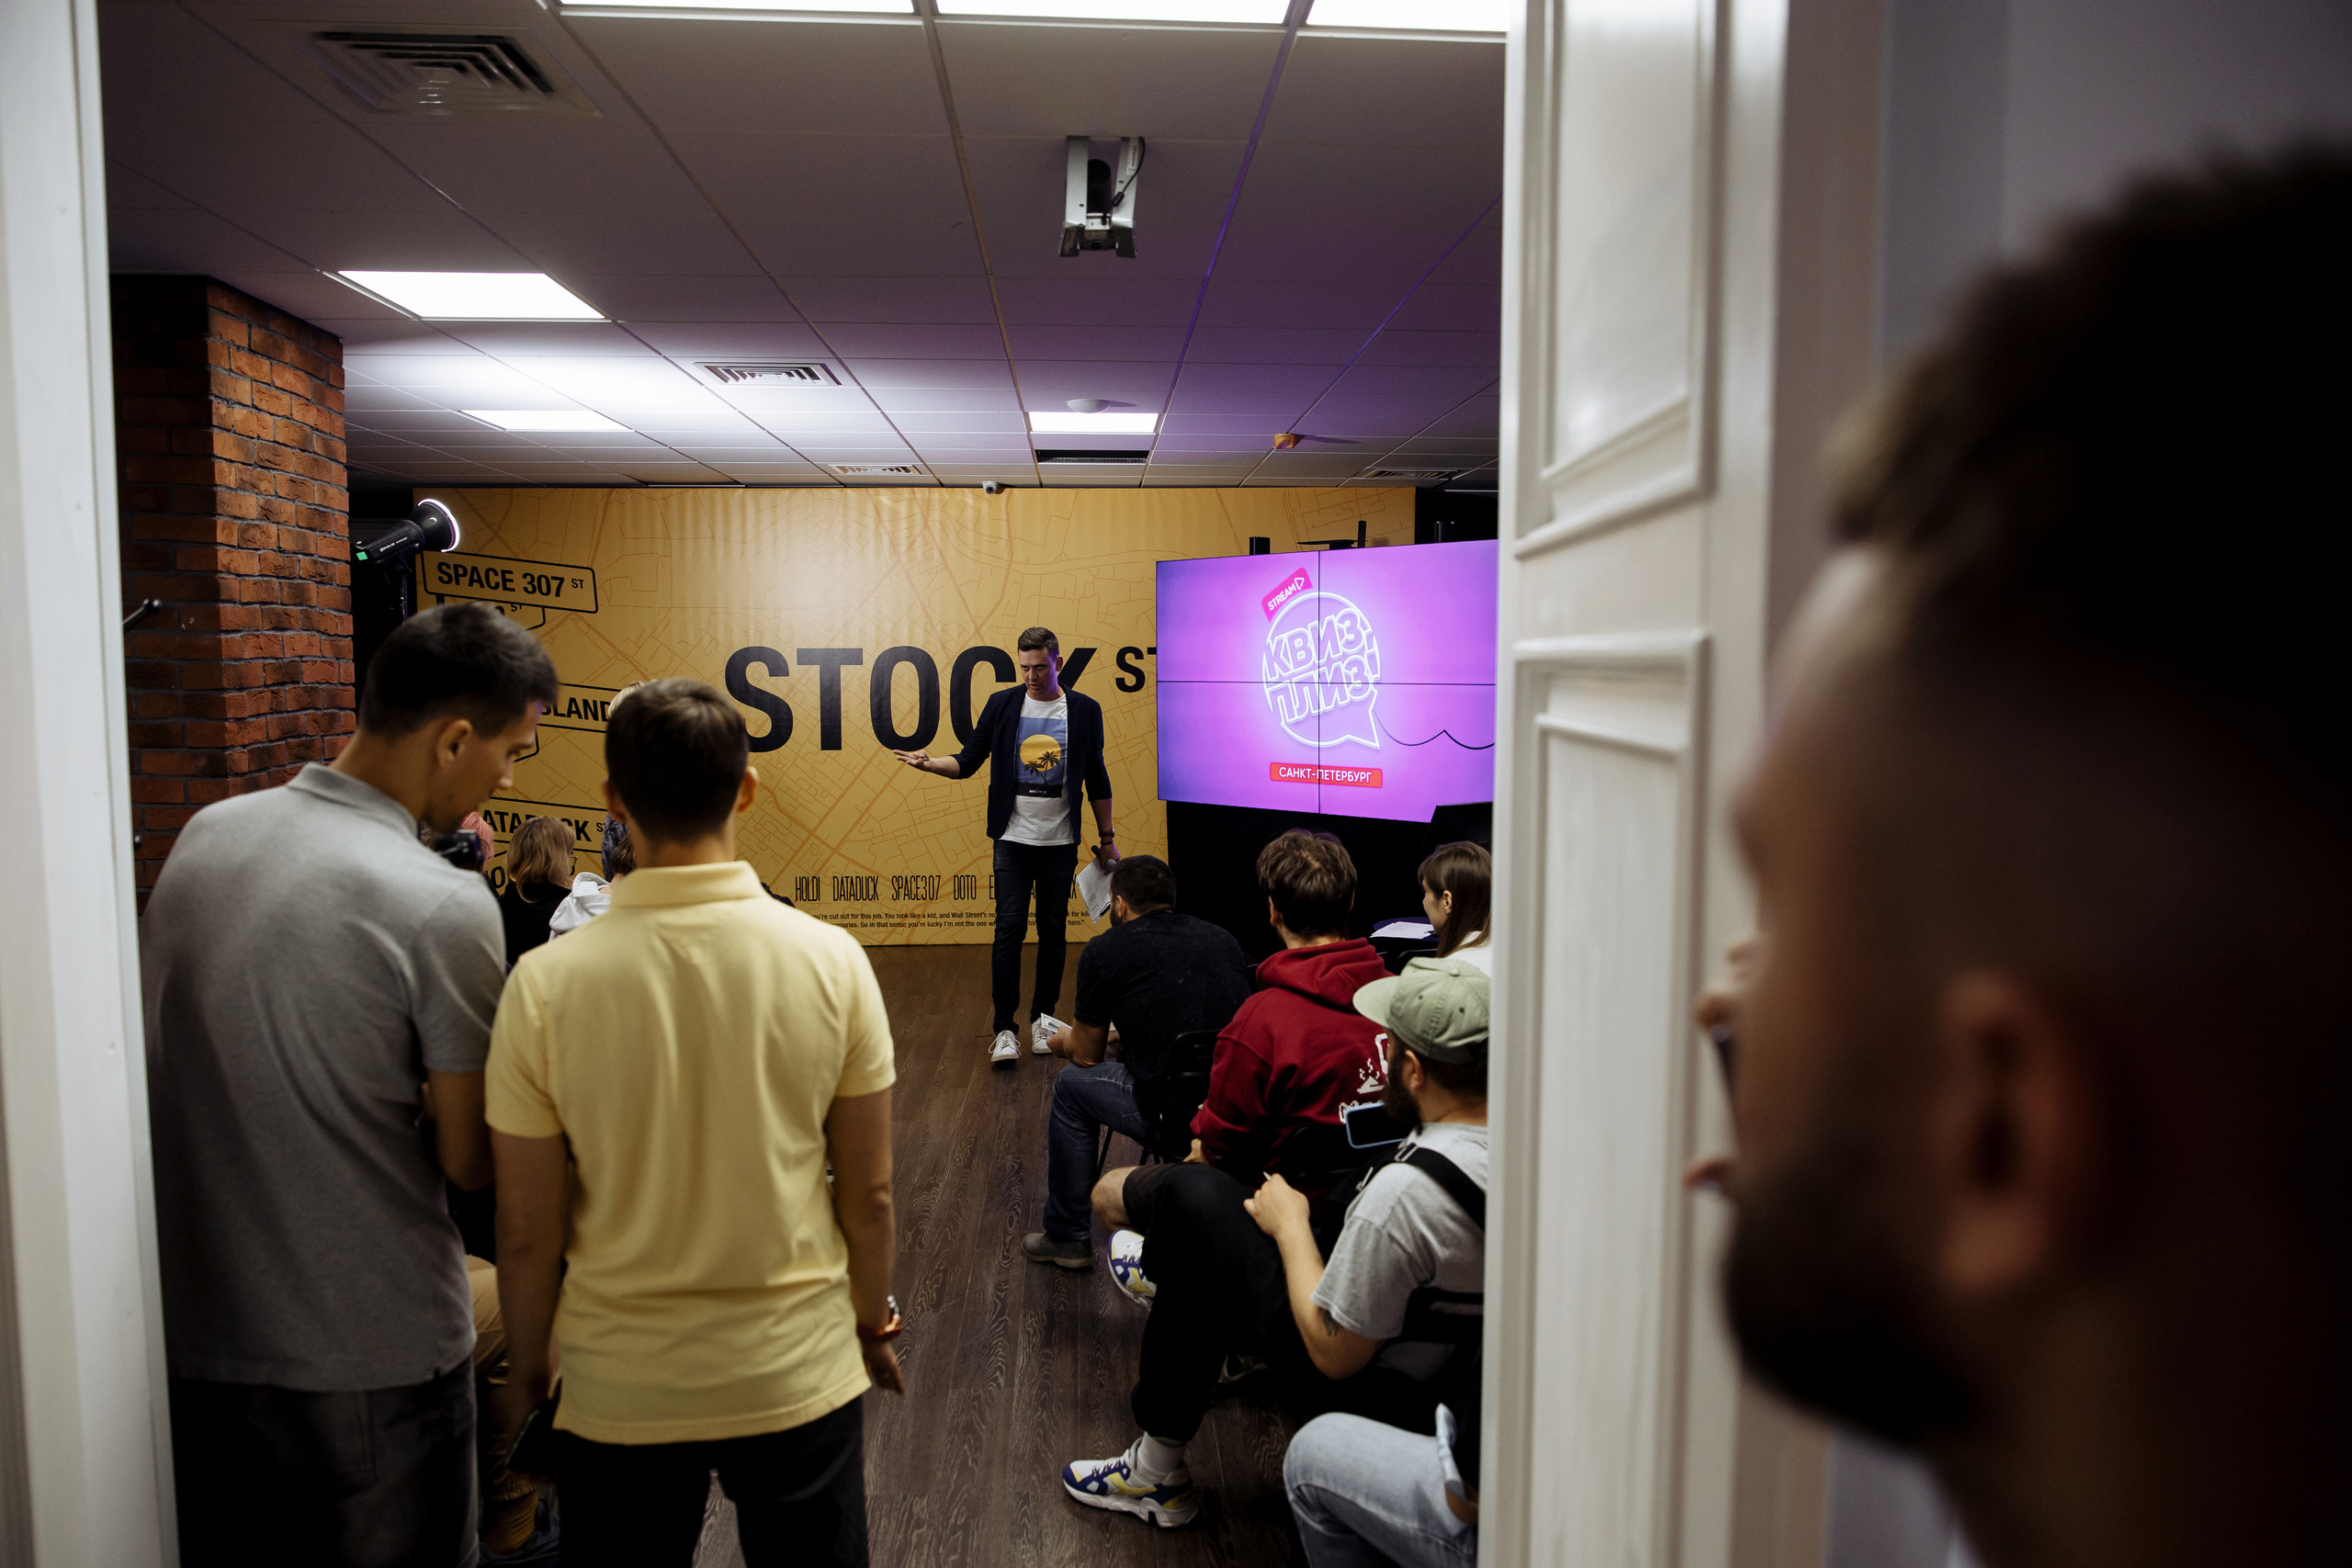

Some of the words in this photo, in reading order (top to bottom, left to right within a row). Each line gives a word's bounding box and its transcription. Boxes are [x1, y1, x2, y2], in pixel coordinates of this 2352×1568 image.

[437, 561, 515, 592] SPACE
[522, 572, 565, 597] 307
[571, 578, 584, 589] ST
[1268, 582, 1296, 611] STREAM
[1278, 766, 1373, 783] САНКТ-ПЕТЕРБУРГ
[795, 876, 820, 901] HOLDI
[832, 875, 879, 901] DATADUCK
[891, 875, 941, 901] SPACE307
[953, 874, 977, 900] DOTO
[872, 912, 883, 920] job.
